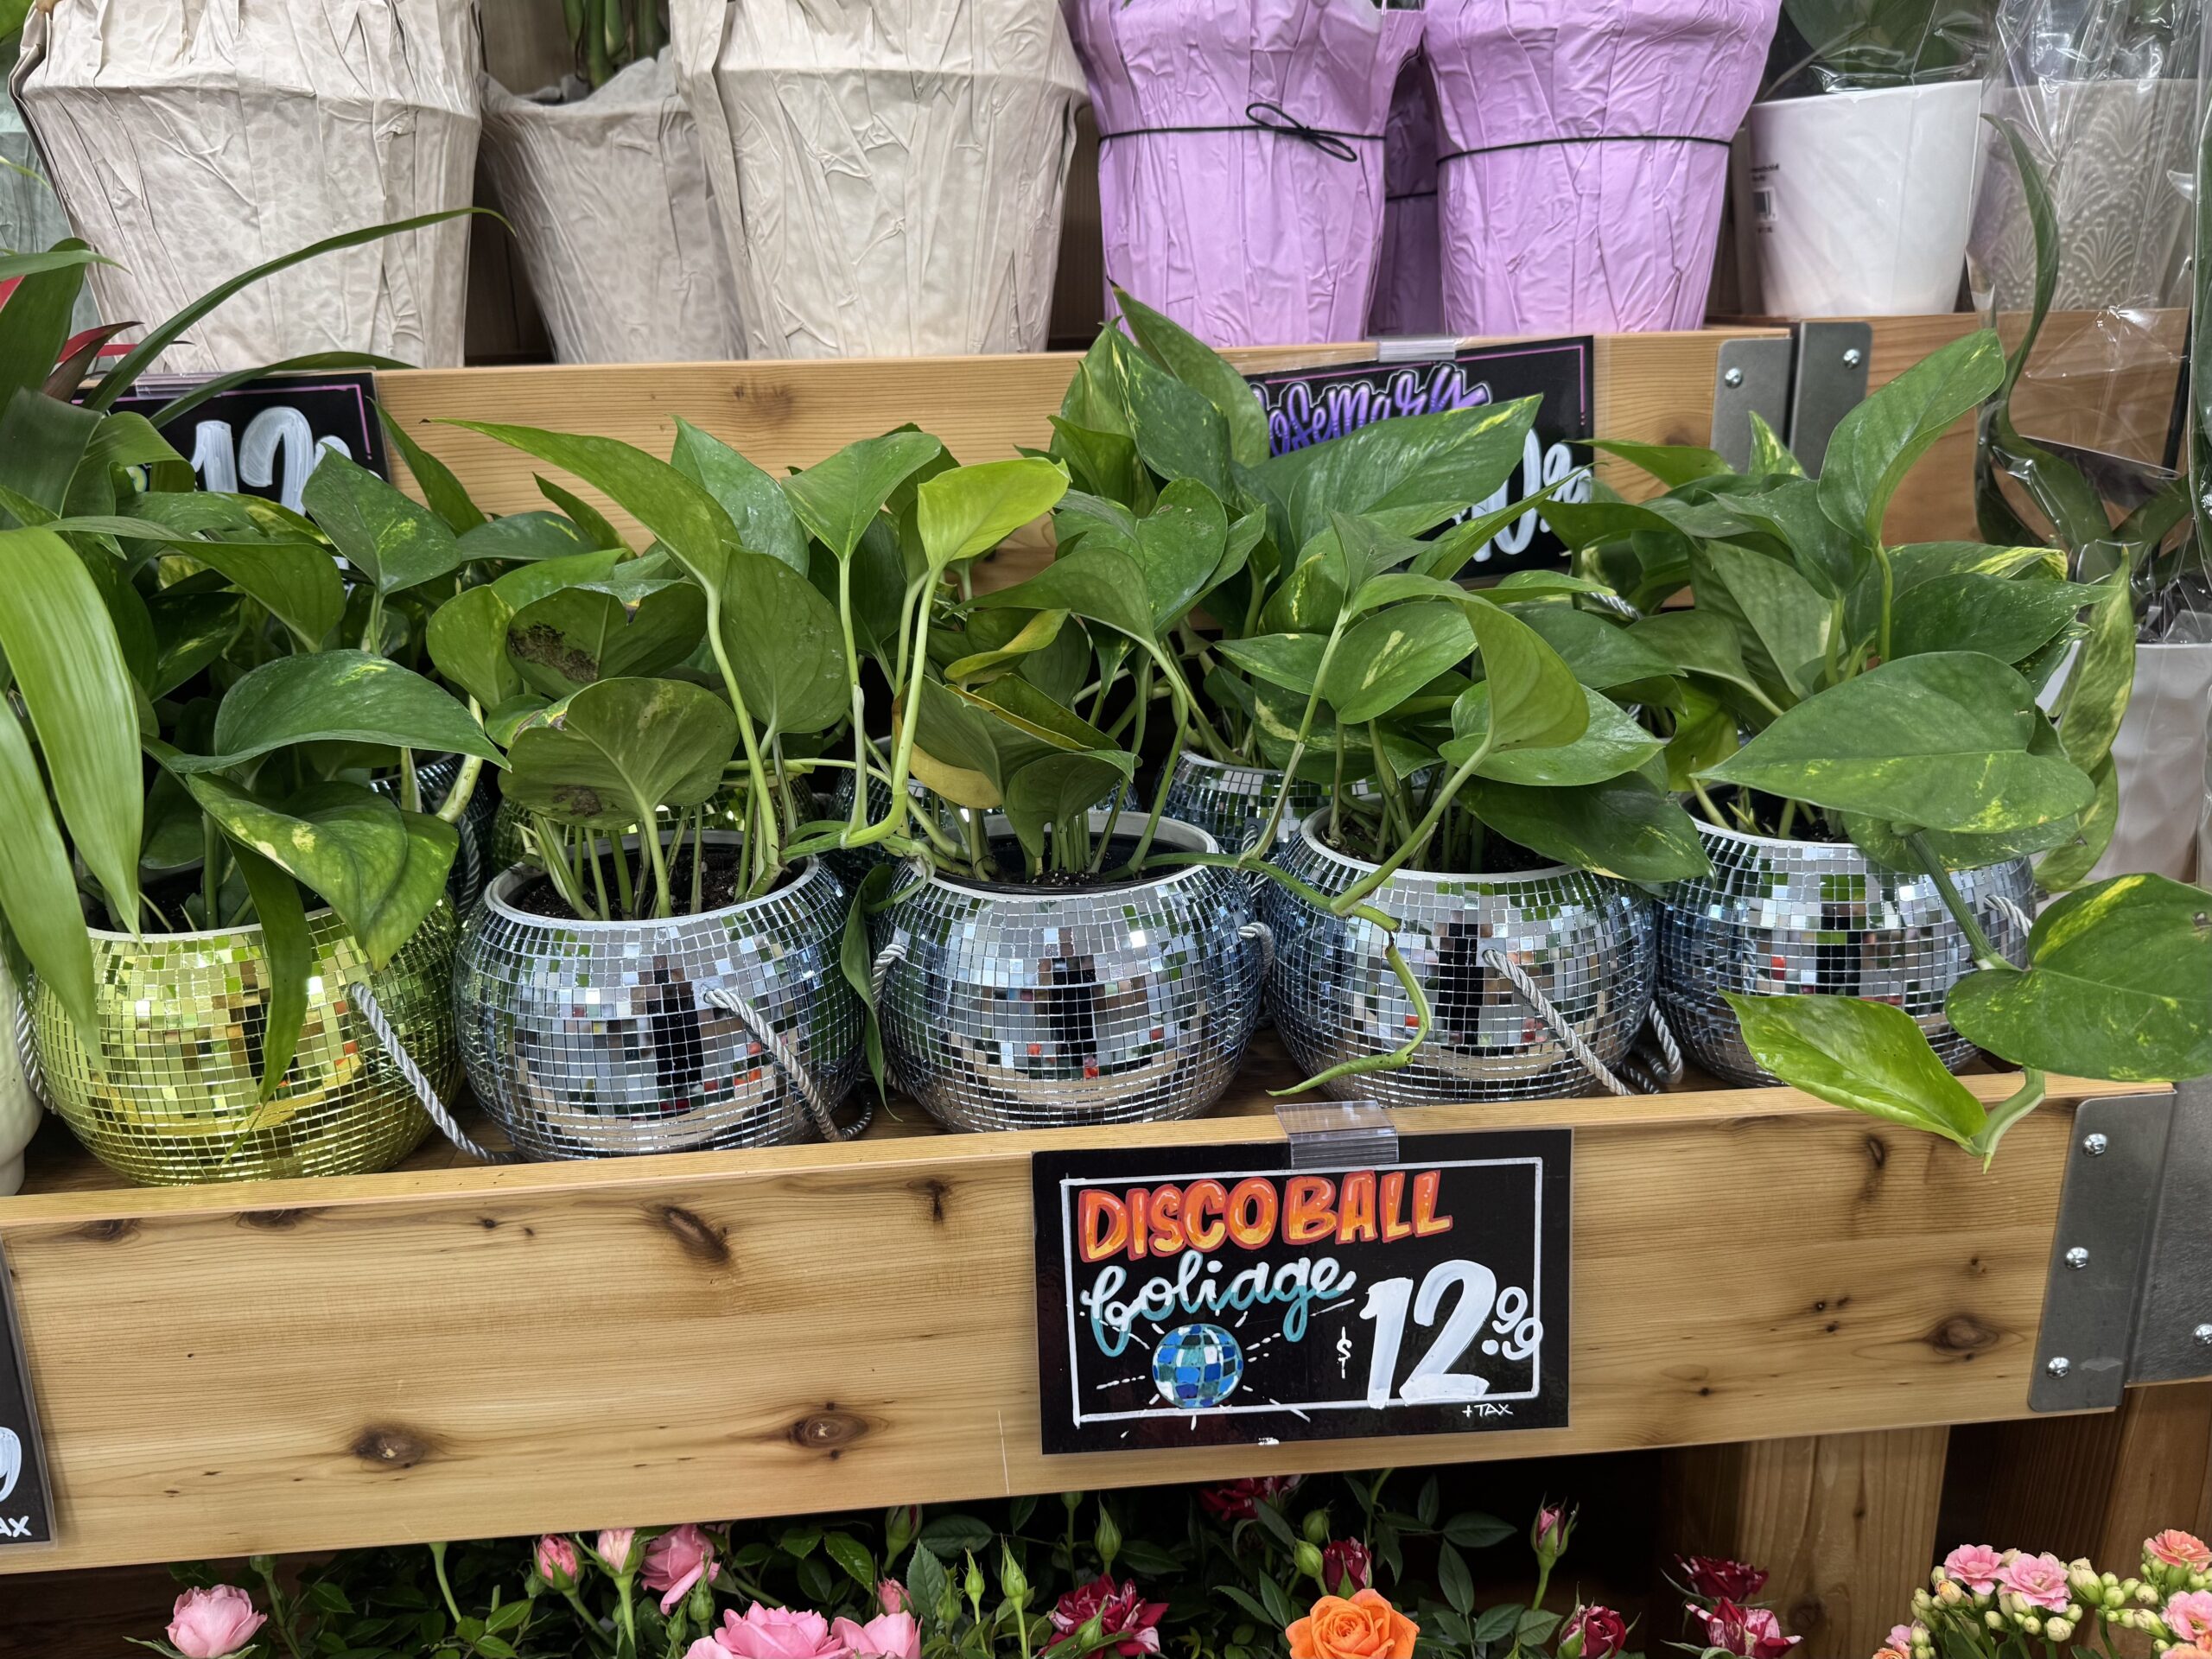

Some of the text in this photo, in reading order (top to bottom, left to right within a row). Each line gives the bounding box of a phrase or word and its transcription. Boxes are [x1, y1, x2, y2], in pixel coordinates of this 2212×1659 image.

[1078, 1169, 1453, 1262] DISCO BALL
[1080, 1249, 1357, 1357] foliage
[1462, 1402, 1514, 1418] +TAX
